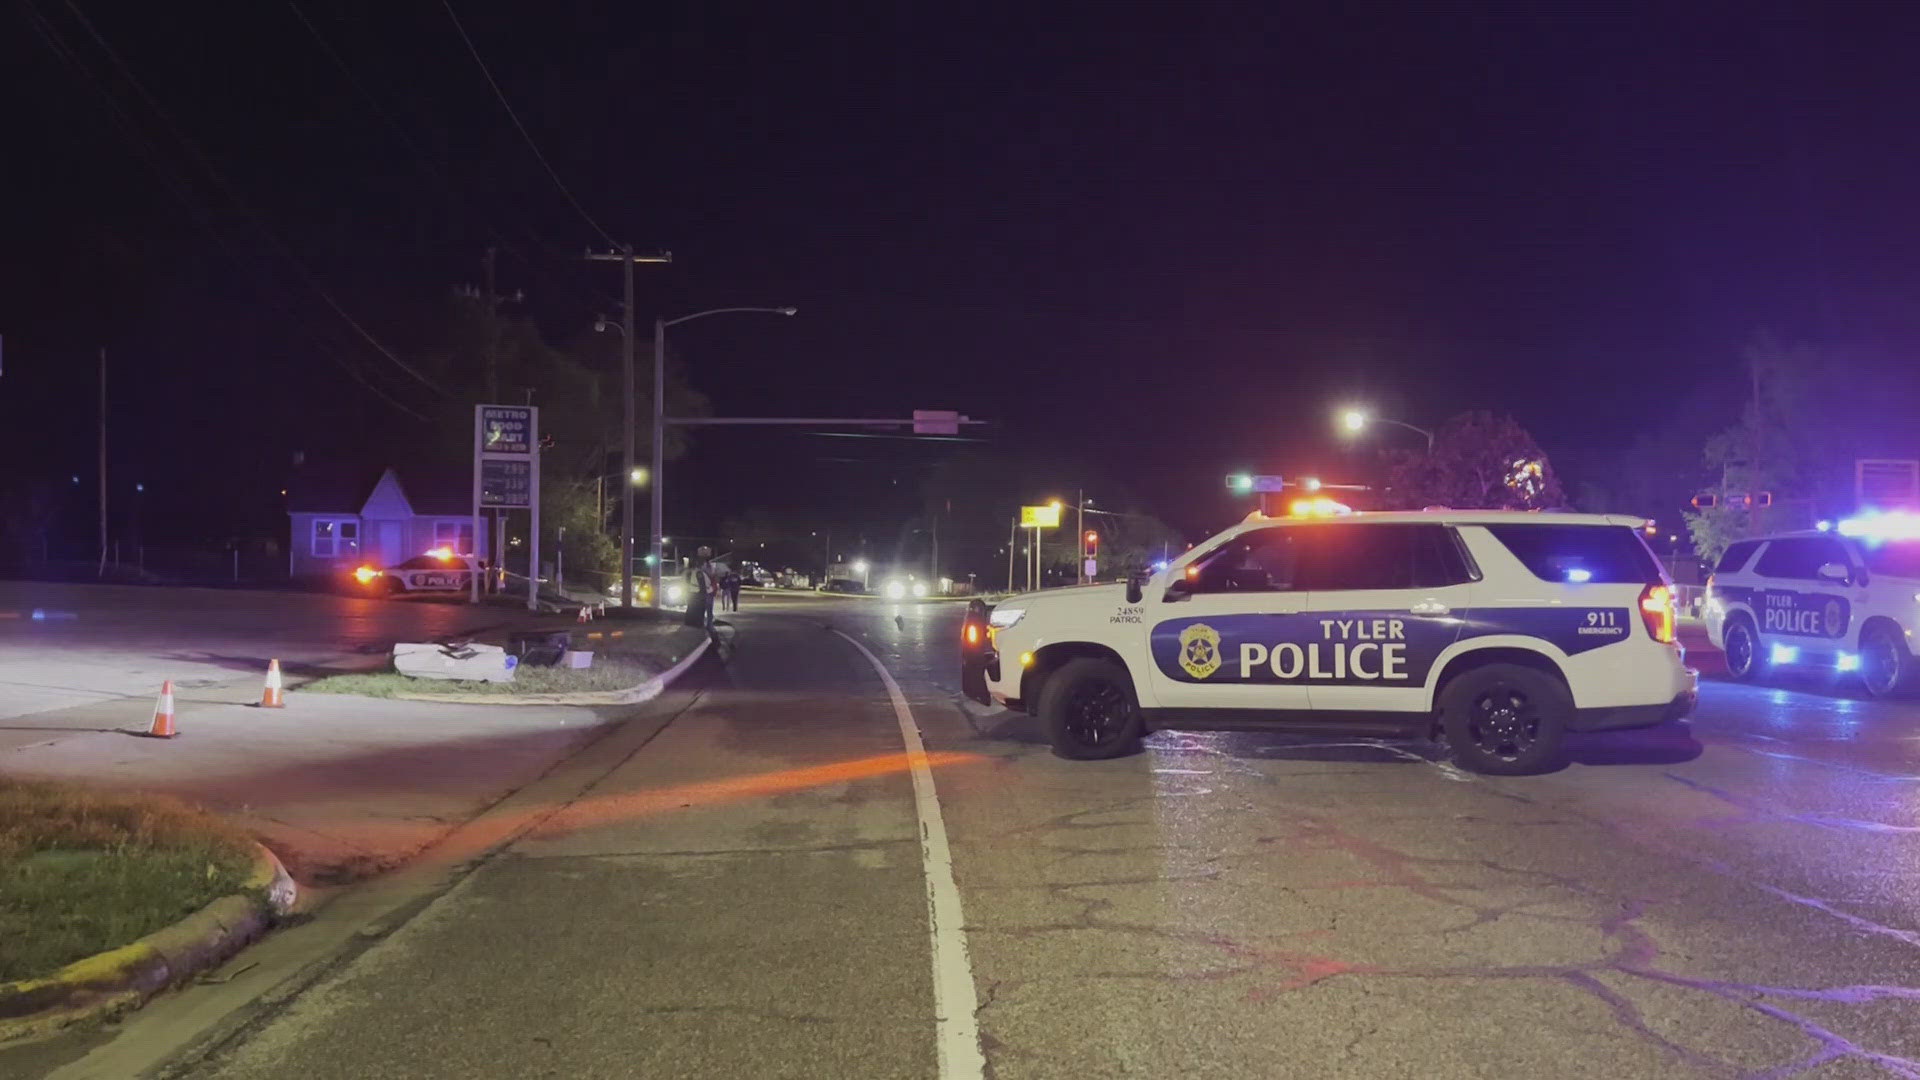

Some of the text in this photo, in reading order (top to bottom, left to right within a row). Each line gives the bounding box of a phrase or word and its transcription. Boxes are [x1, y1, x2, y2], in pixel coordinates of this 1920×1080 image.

[485, 410, 528, 419] METRO
[1766, 594, 1792, 608] TYLER
[1117, 606, 1144, 616] 24859
[1110, 616, 1142, 624] PATROL
[1587, 612, 1615, 626] 911
[1765, 608, 1820, 634] POLICE
[1320, 620, 1405, 640] TYLER
[1577, 627, 1623, 635] EMERGENCY
[1185, 661, 1216, 674] POLICE
[1240, 643, 1408, 680] POLICE
